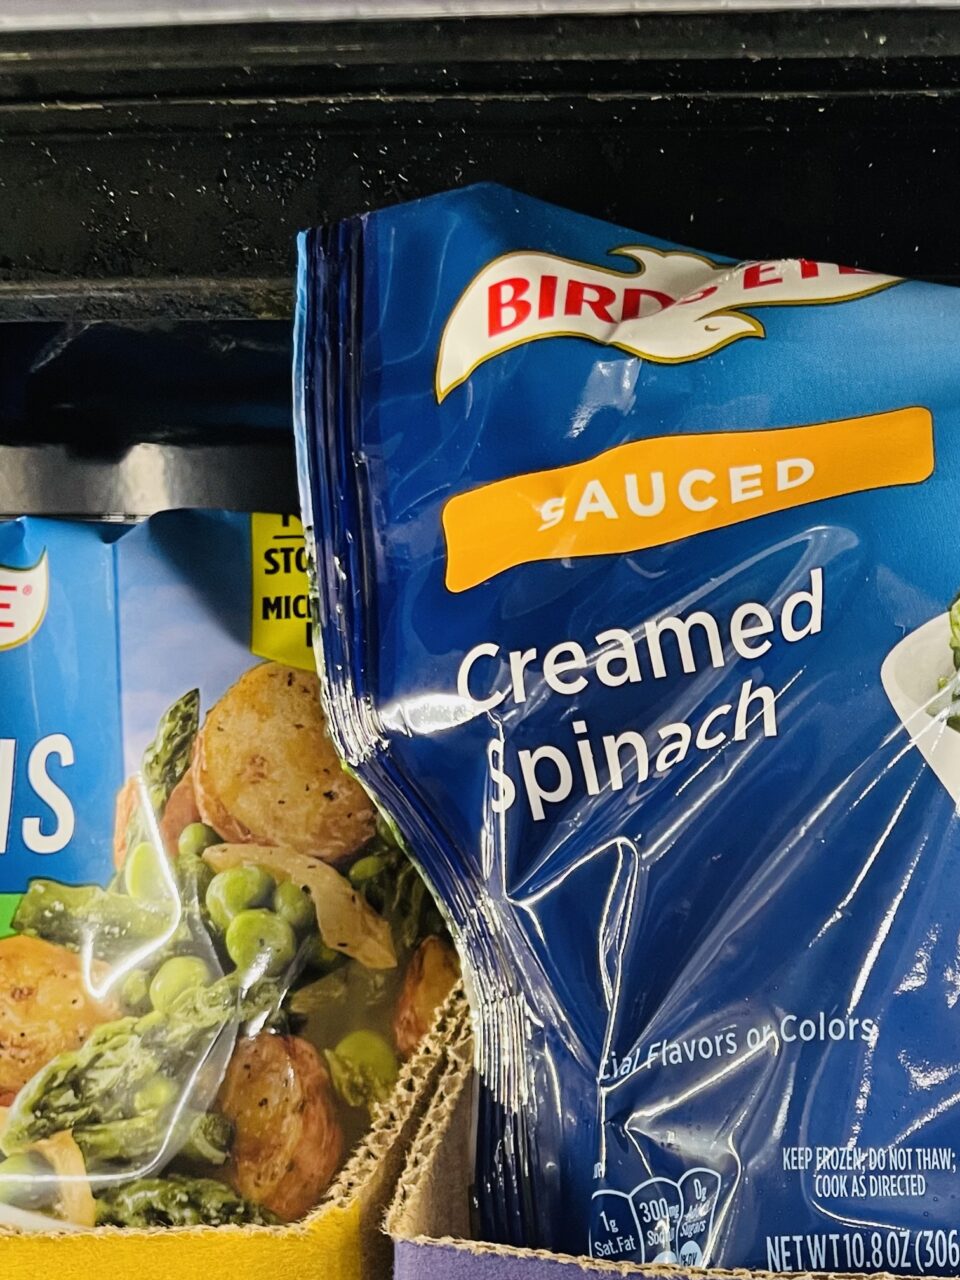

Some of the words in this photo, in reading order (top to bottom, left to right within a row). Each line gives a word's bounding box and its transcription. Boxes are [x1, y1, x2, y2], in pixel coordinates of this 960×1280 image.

[487, 273, 718, 338] BIRD
[537, 458, 815, 532] SAUCED
[457, 568, 823, 705] Creamed
[488, 679, 778, 821] Spinach
[646, 1030, 738, 1069] Flavors
[780, 1011, 876, 1042] Colors
[783, 1147, 812, 1170] KEEP
[869, 1147, 886, 1171] DO
[889, 1148, 913, 1171] NOT
[916, 1148, 957, 1173] THAW;
[815, 1175, 848, 1197] COOK
[851, 1175, 867, 1197] AS
[869, 1175, 926, 1197] DIRECTED
[600, 1210, 619, 1233] 1g
[766, 1235, 806, 1272] NET
[807, 1233, 839, 1268] WT
[843, 1232, 883, 1268] 10.8
[886, 1229, 912, 1267] OZ
